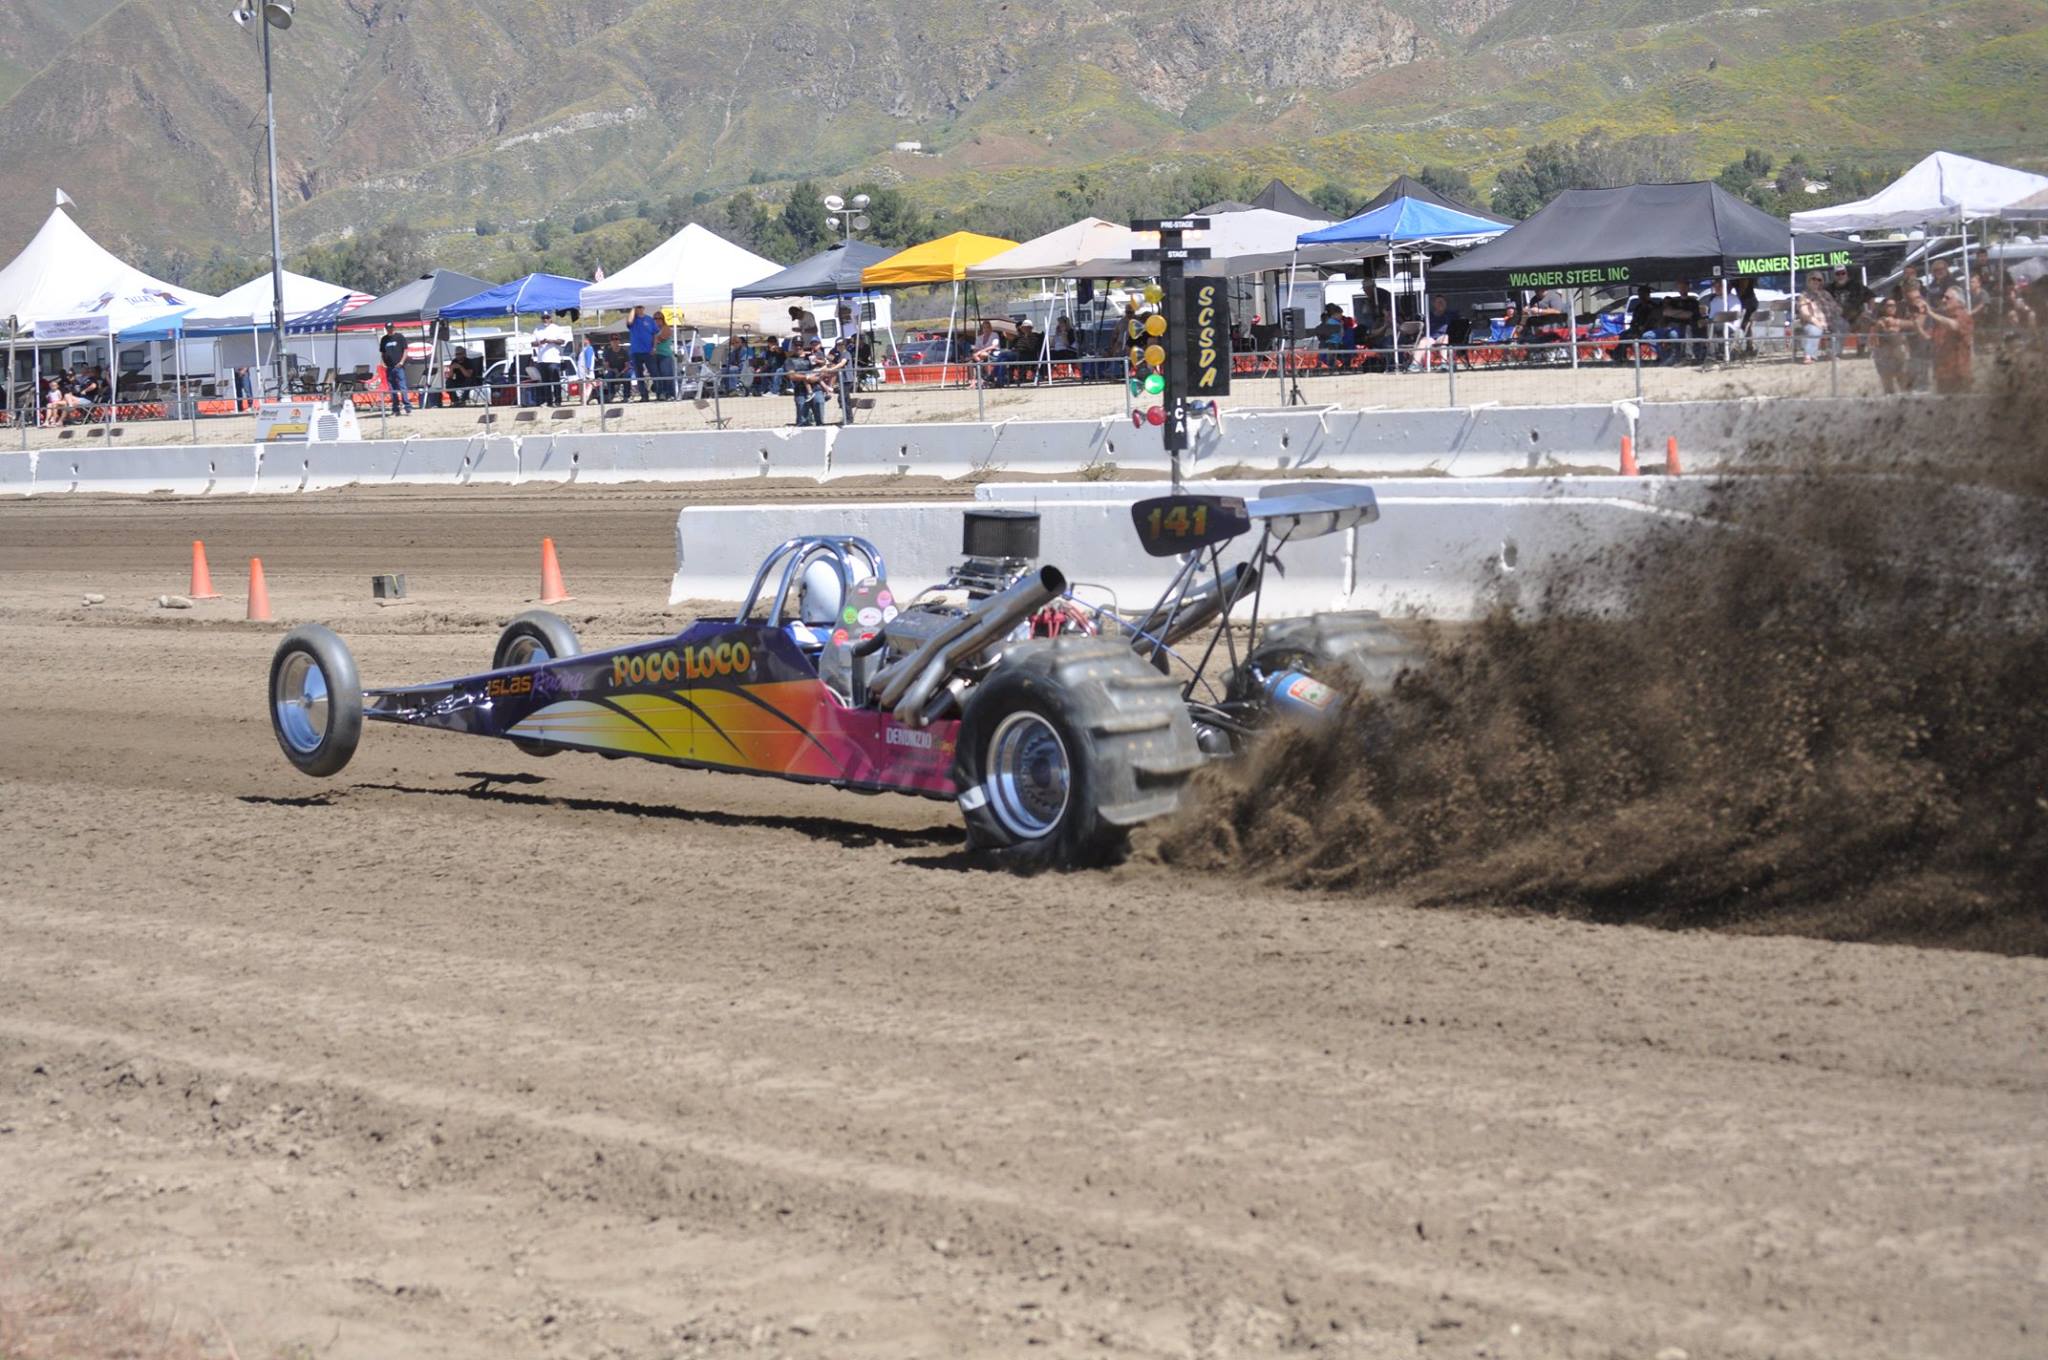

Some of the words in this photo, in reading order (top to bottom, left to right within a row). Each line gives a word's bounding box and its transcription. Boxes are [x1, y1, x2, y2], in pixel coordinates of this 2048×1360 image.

[1160, 220, 1194, 229] PRE-STAGE
[1167, 250, 1188, 258] STAGE
[1737, 256, 1790, 274] WAGNER
[1791, 253, 1828, 270] STEEL
[1830, 250, 1853, 266] INC.
[1509, 271, 1563, 287] WAGNER
[1566, 269, 1606, 284] STEEL
[1607, 266, 1630, 281] INC
[1198, 285, 1217, 388] SCSDA
[1174, 397, 1185, 433] ICA
[1147, 505, 1208, 540] 141
[612, 651, 679, 687] POCO
[685, 641, 750, 679] LOCO
